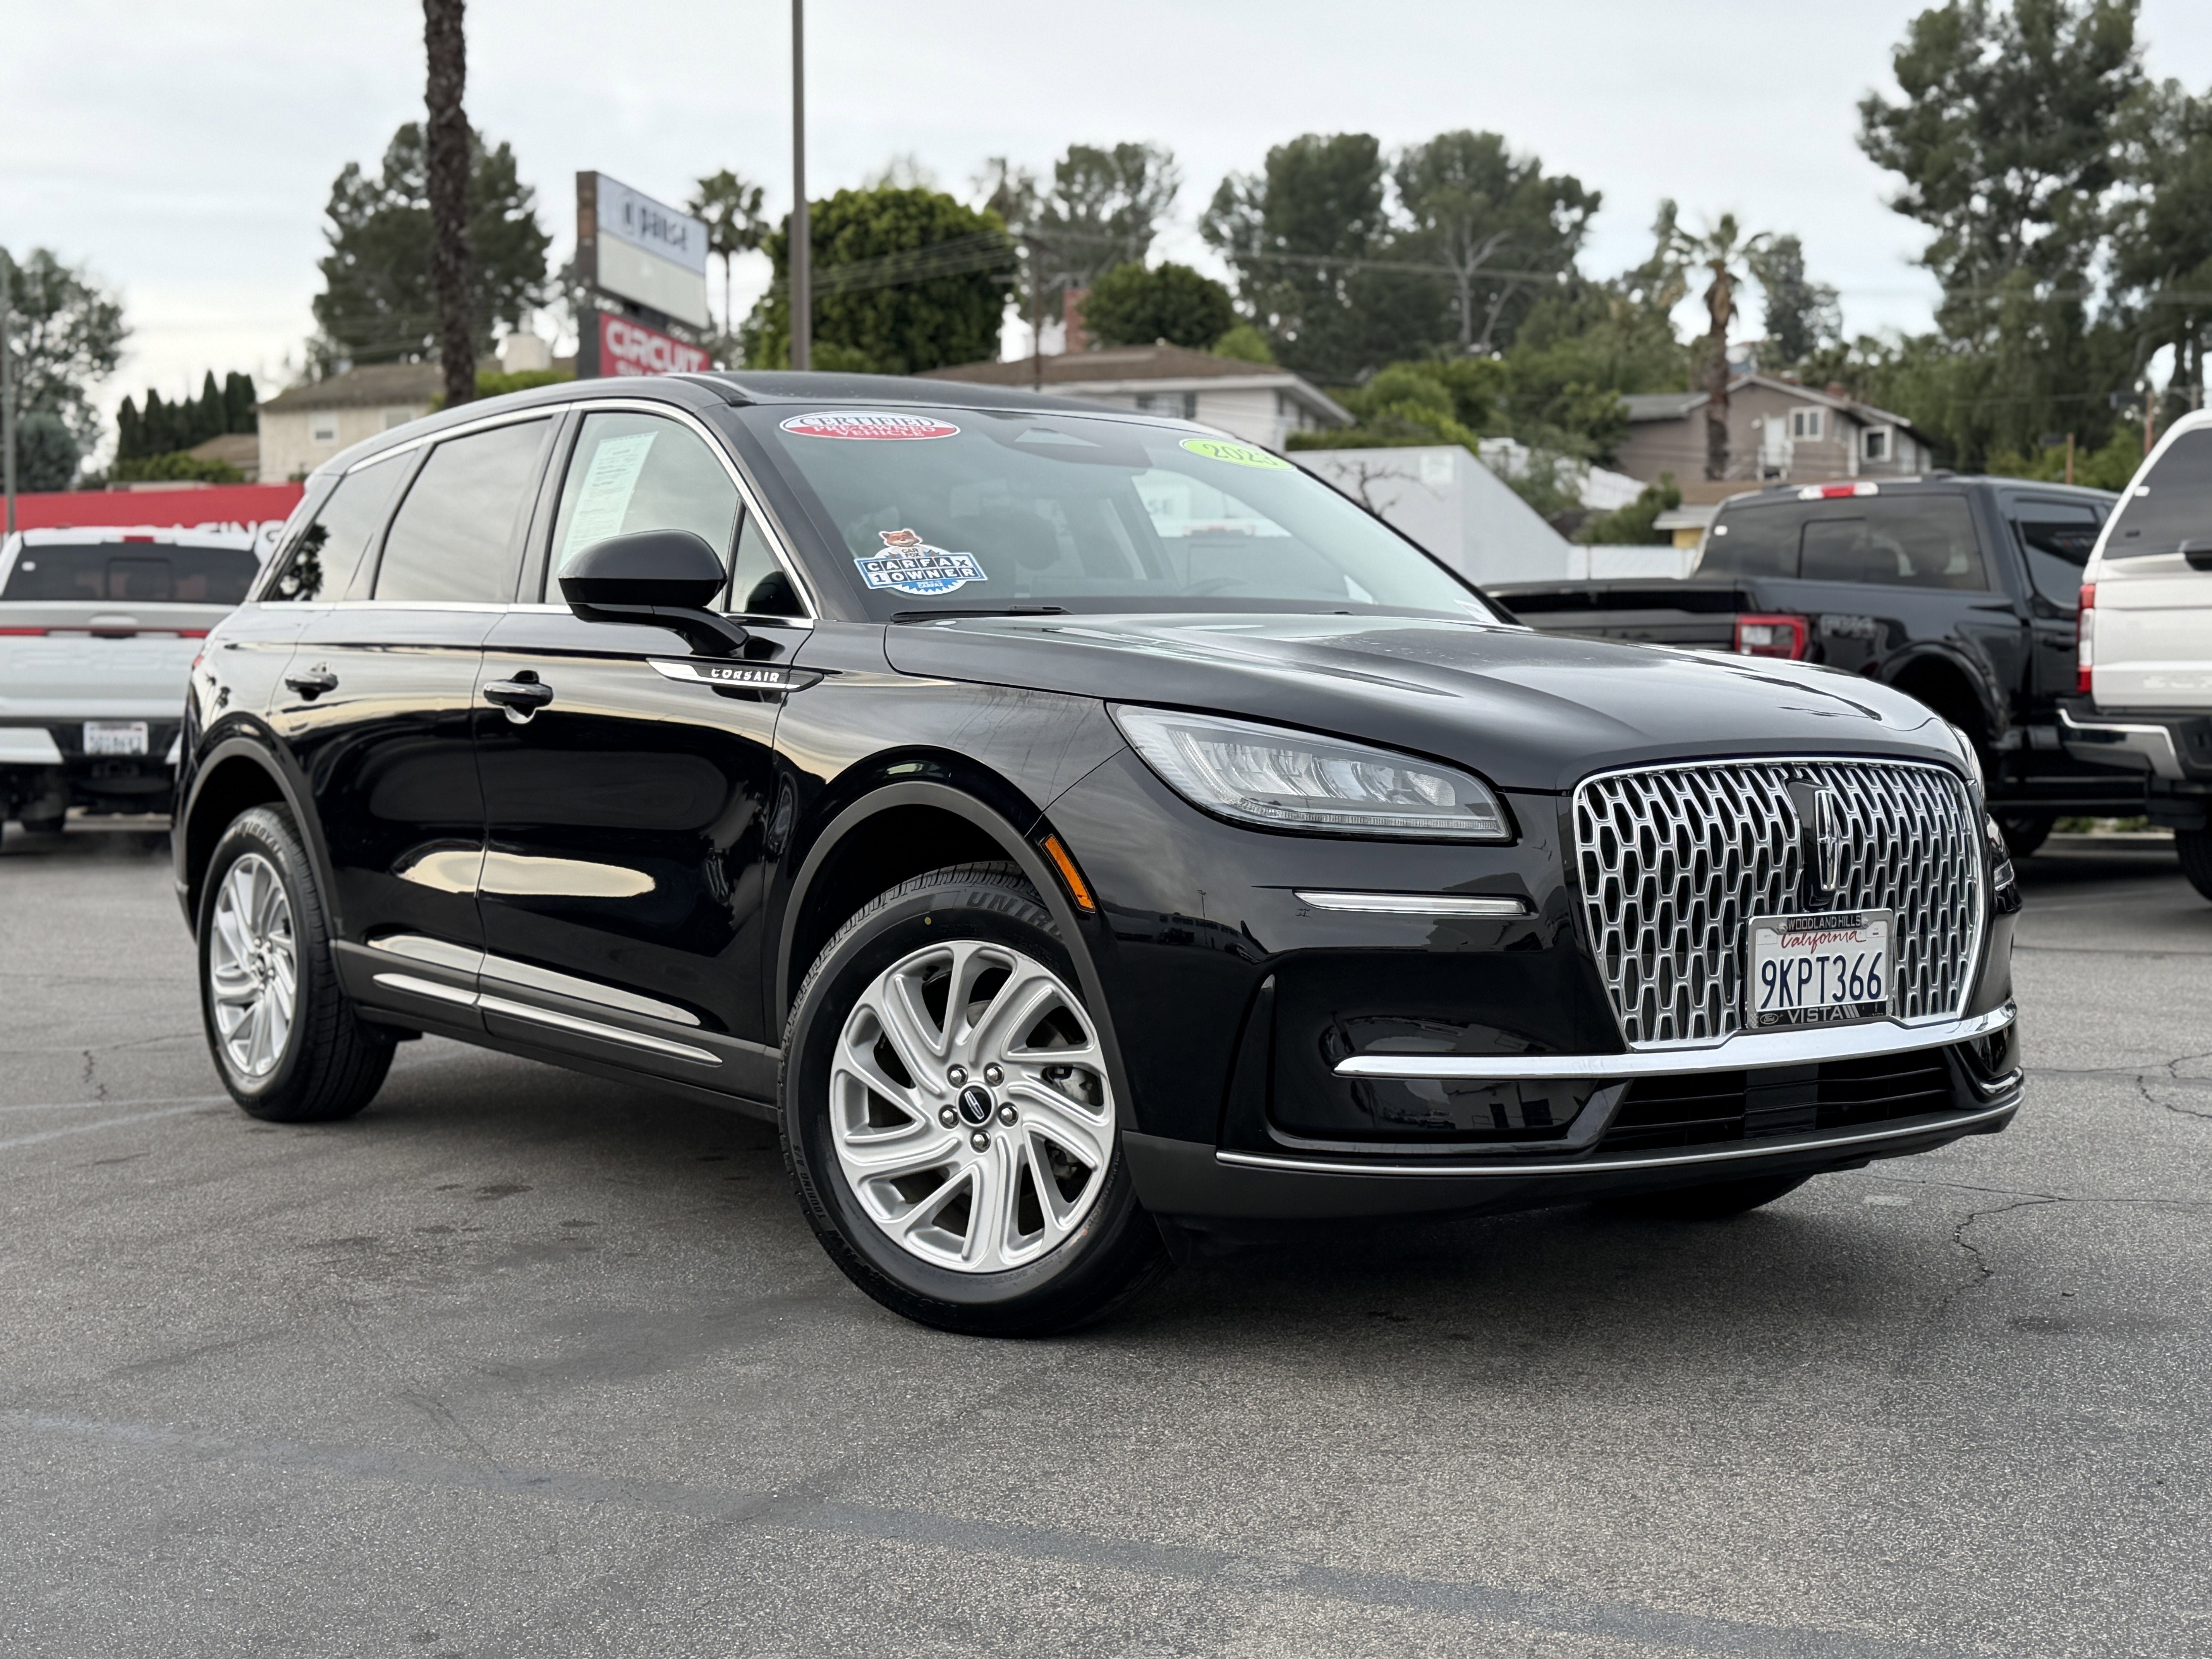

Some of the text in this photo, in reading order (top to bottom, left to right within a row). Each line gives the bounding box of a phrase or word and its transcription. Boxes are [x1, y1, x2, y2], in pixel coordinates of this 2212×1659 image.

[606, 319, 703, 373] CIRCUIT
[800, 417, 935, 426] CERTIFIED
[1203, 443, 1279, 466] 2023
[867, 558, 970, 572] CARFAX
[874, 568, 976, 583] 1 OWNER
[711, 668, 779, 682] CORSAIR
[1788, 914, 1862, 930] WOODLAND HILLS
[1781, 930, 1867, 954] California
[1760, 951, 1883, 1009] 9KPT366
[793, 1144, 826, 1219] TOURING A/S
